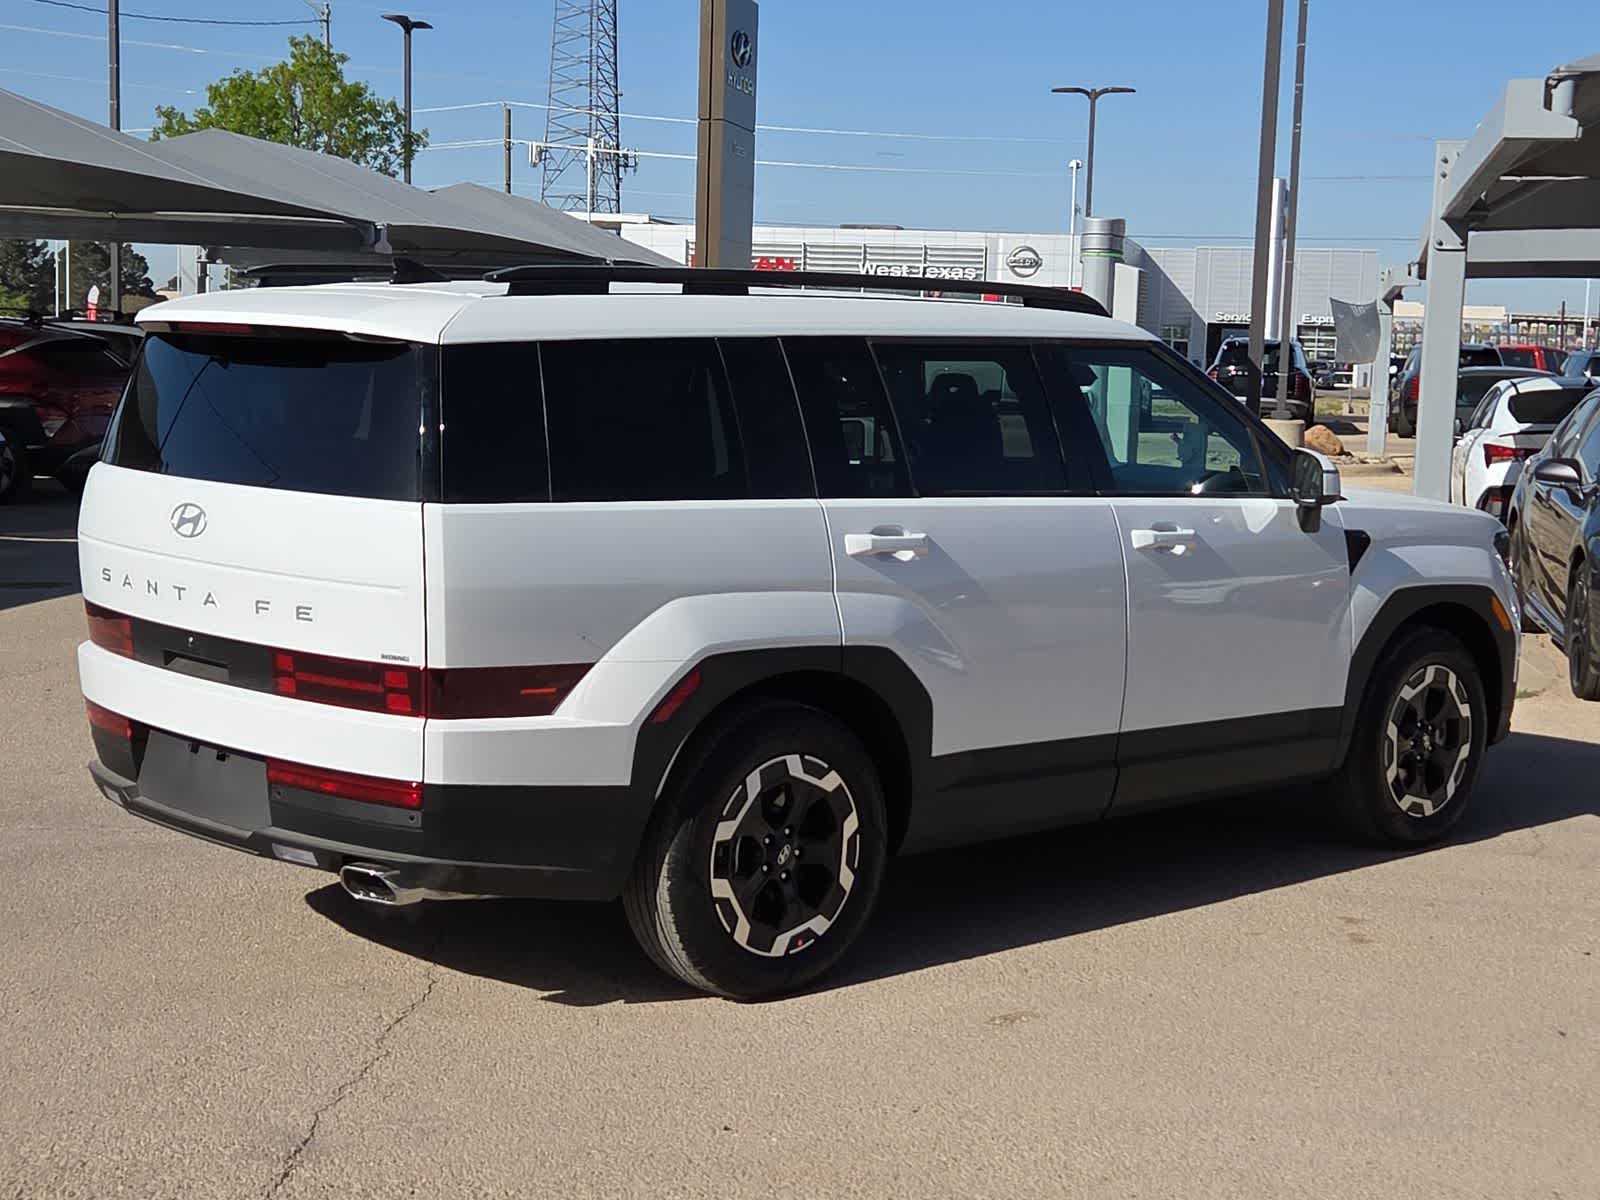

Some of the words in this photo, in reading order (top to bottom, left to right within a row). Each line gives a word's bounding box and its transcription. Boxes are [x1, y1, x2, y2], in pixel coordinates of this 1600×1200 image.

[859, 261, 912, 277] West
[914, 263, 977, 280] Texas
[1216, 311, 1252, 321] Servic
[1302, 313, 1335, 325] Expr
[102, 567, 217, 608] SANTA
[255, 600, 313, 622] FE
